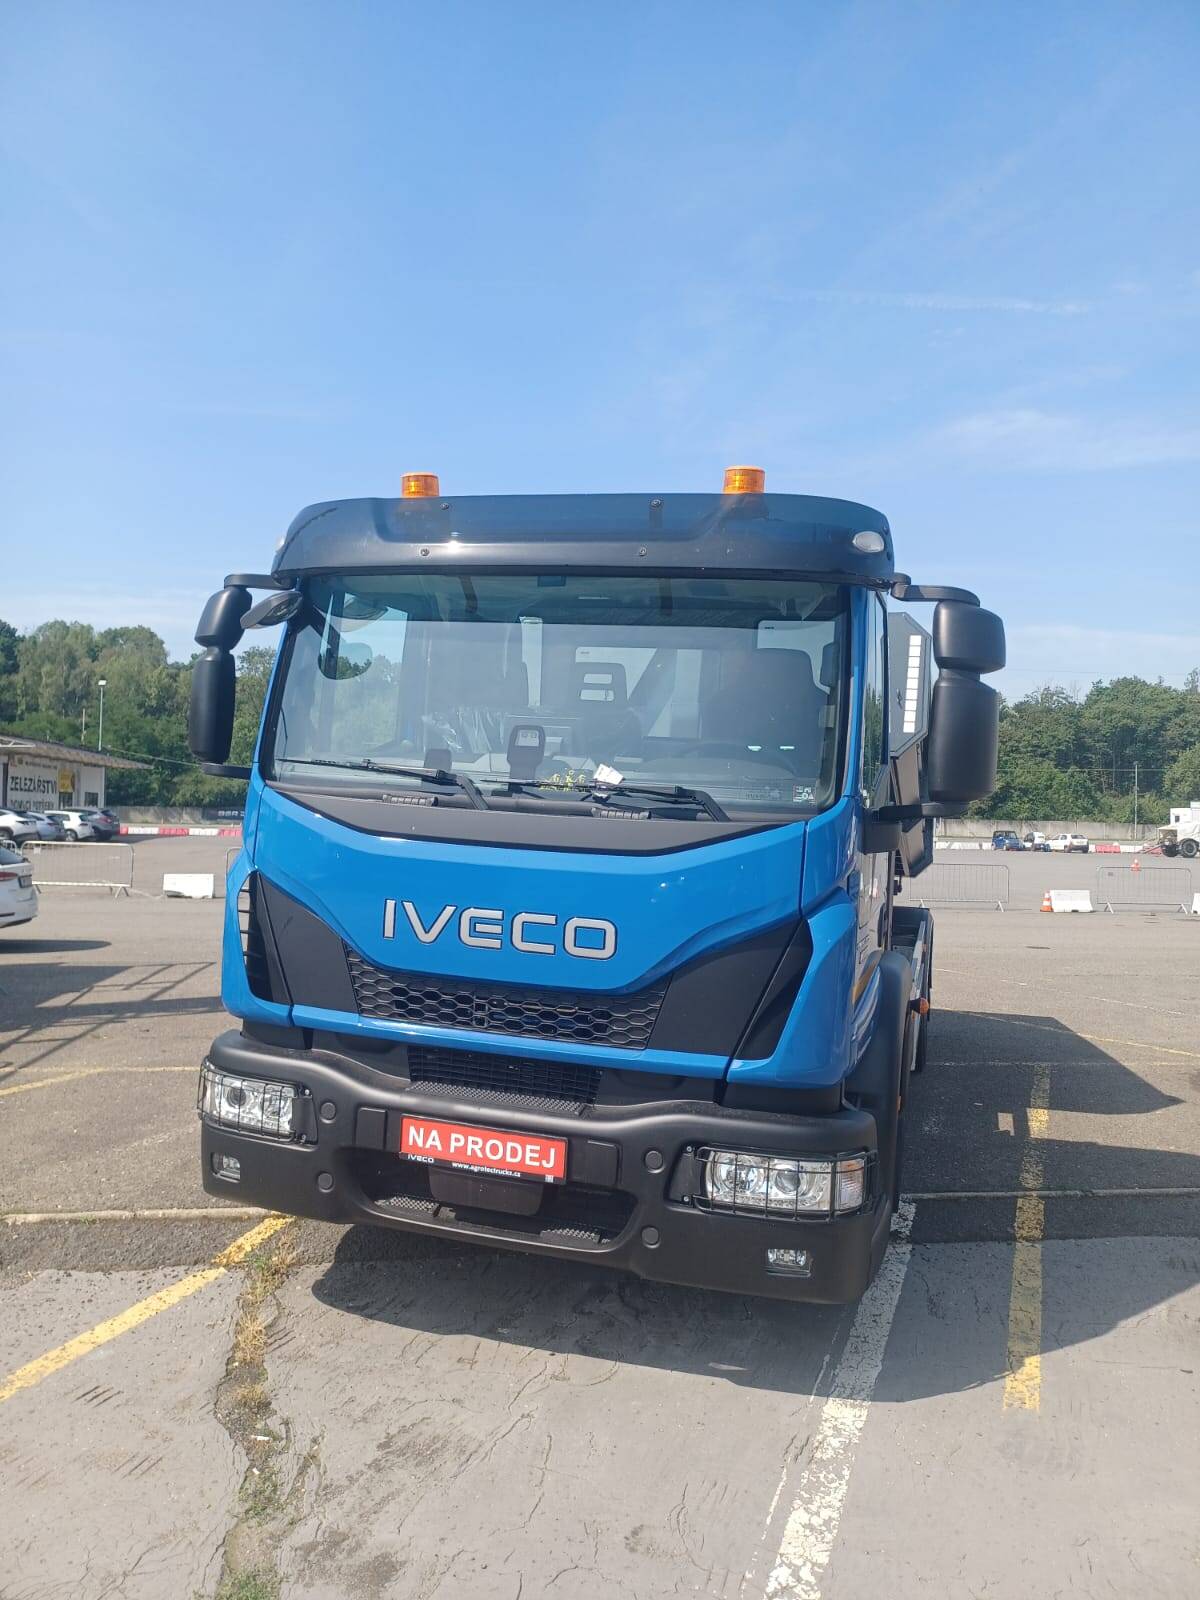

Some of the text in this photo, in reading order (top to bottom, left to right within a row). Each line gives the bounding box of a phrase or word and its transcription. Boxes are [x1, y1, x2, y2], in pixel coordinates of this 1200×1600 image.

[383, 898, 618, 961] IVECO
[408, 1125, 556, 1169] NA PRODEJ
